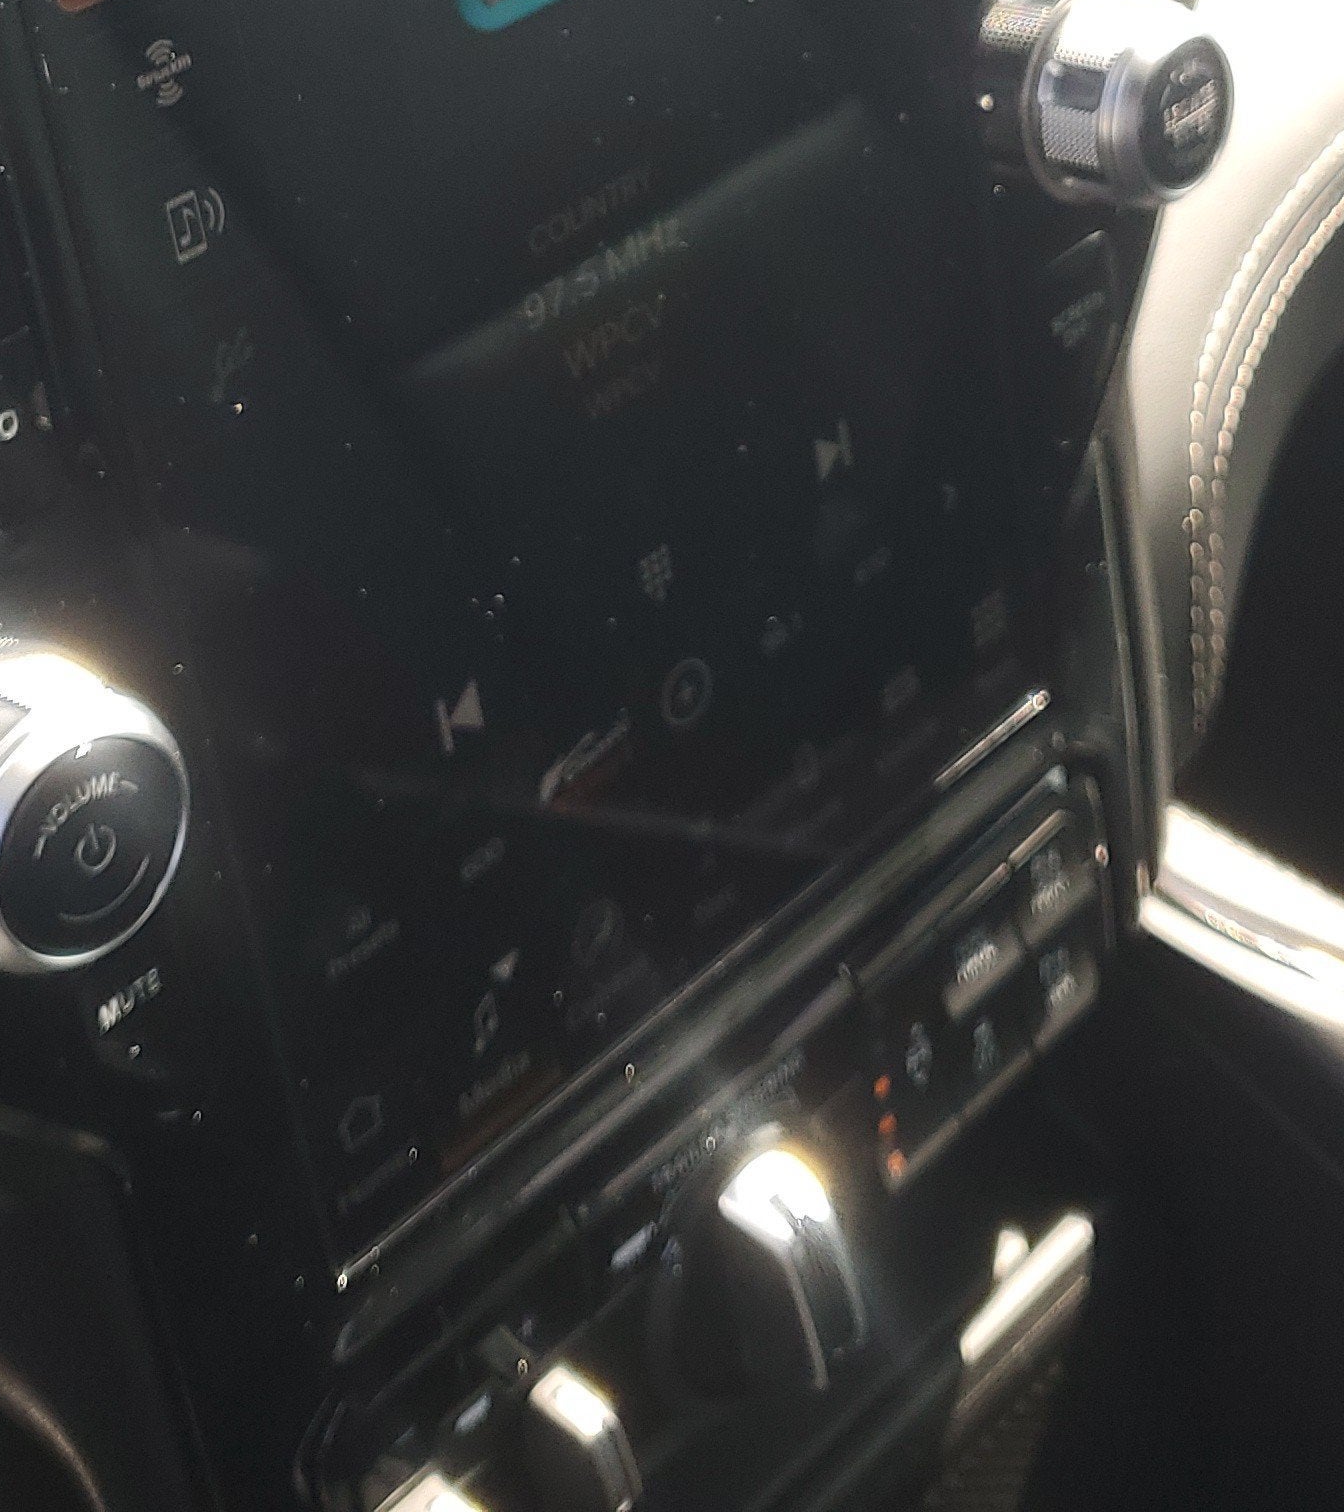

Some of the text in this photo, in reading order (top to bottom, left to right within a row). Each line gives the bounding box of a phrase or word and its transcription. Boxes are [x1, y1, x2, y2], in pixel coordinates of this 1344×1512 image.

[528, 166, 659, 255] COUNTRY
[40, 771, 120, 836] VOLUME
[96, 965, 163, 1036] MUTE
